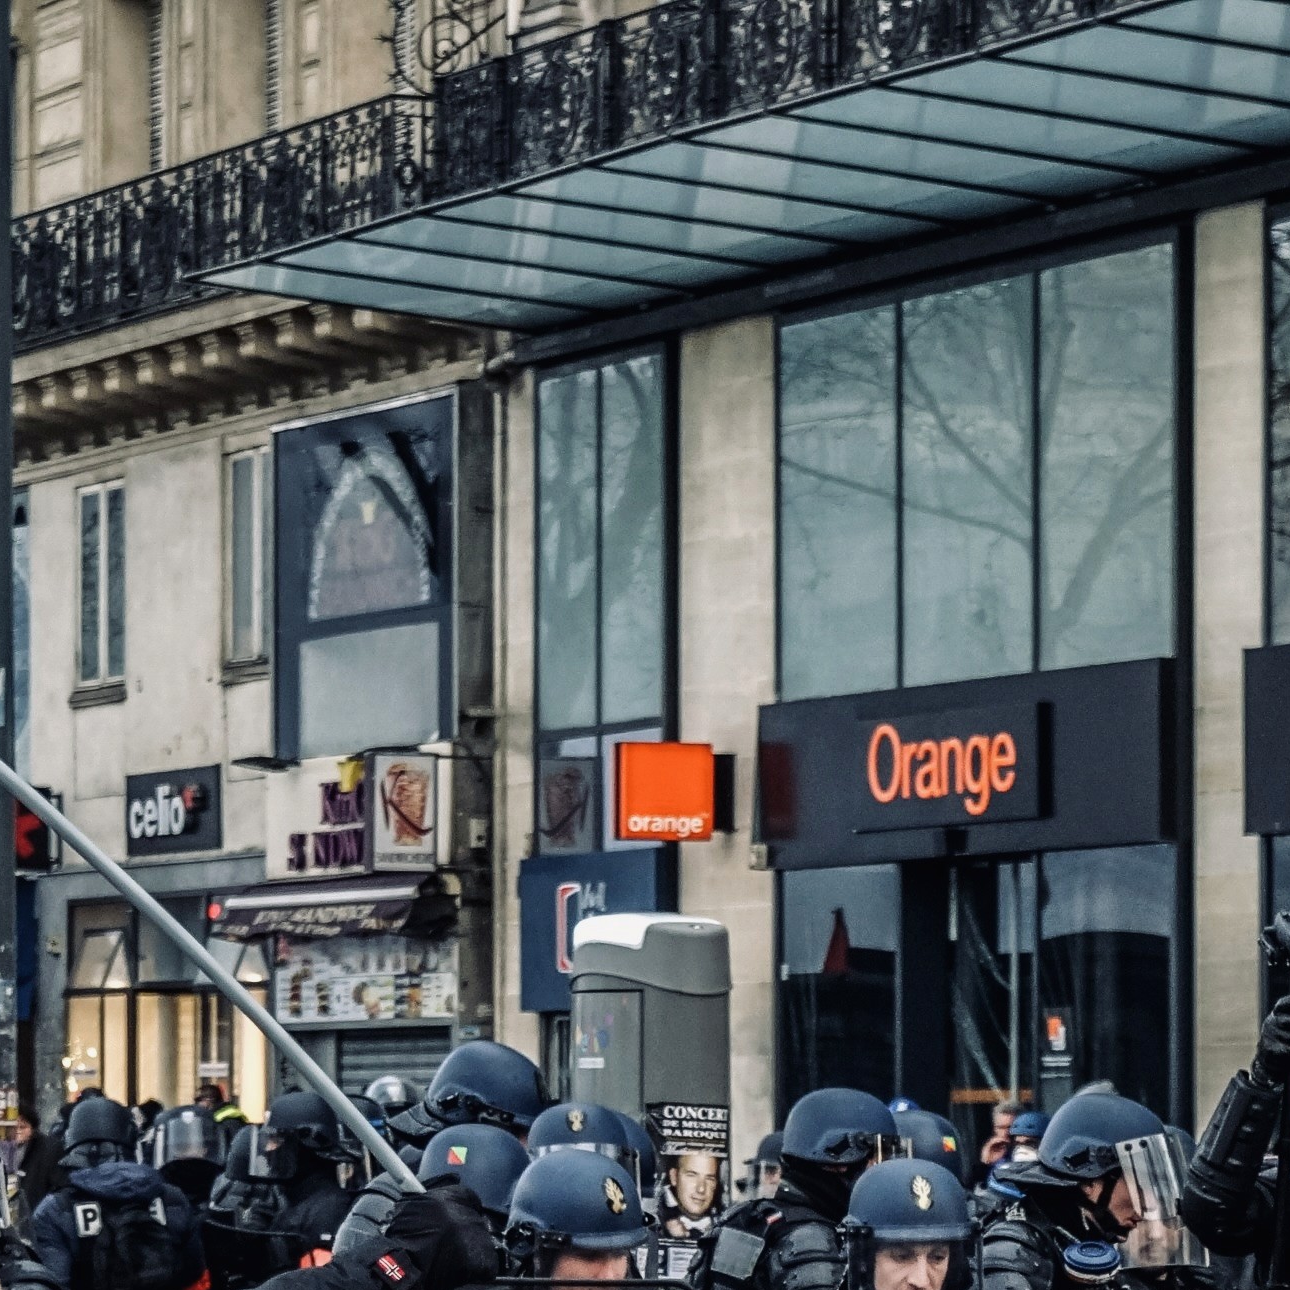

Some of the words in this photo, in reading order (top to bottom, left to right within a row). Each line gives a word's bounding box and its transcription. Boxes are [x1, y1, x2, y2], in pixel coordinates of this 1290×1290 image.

[867, 722, 1017, 816] Orange
[628, 814, 704, 838] orange
[82, 1208, 97, 1231] P
